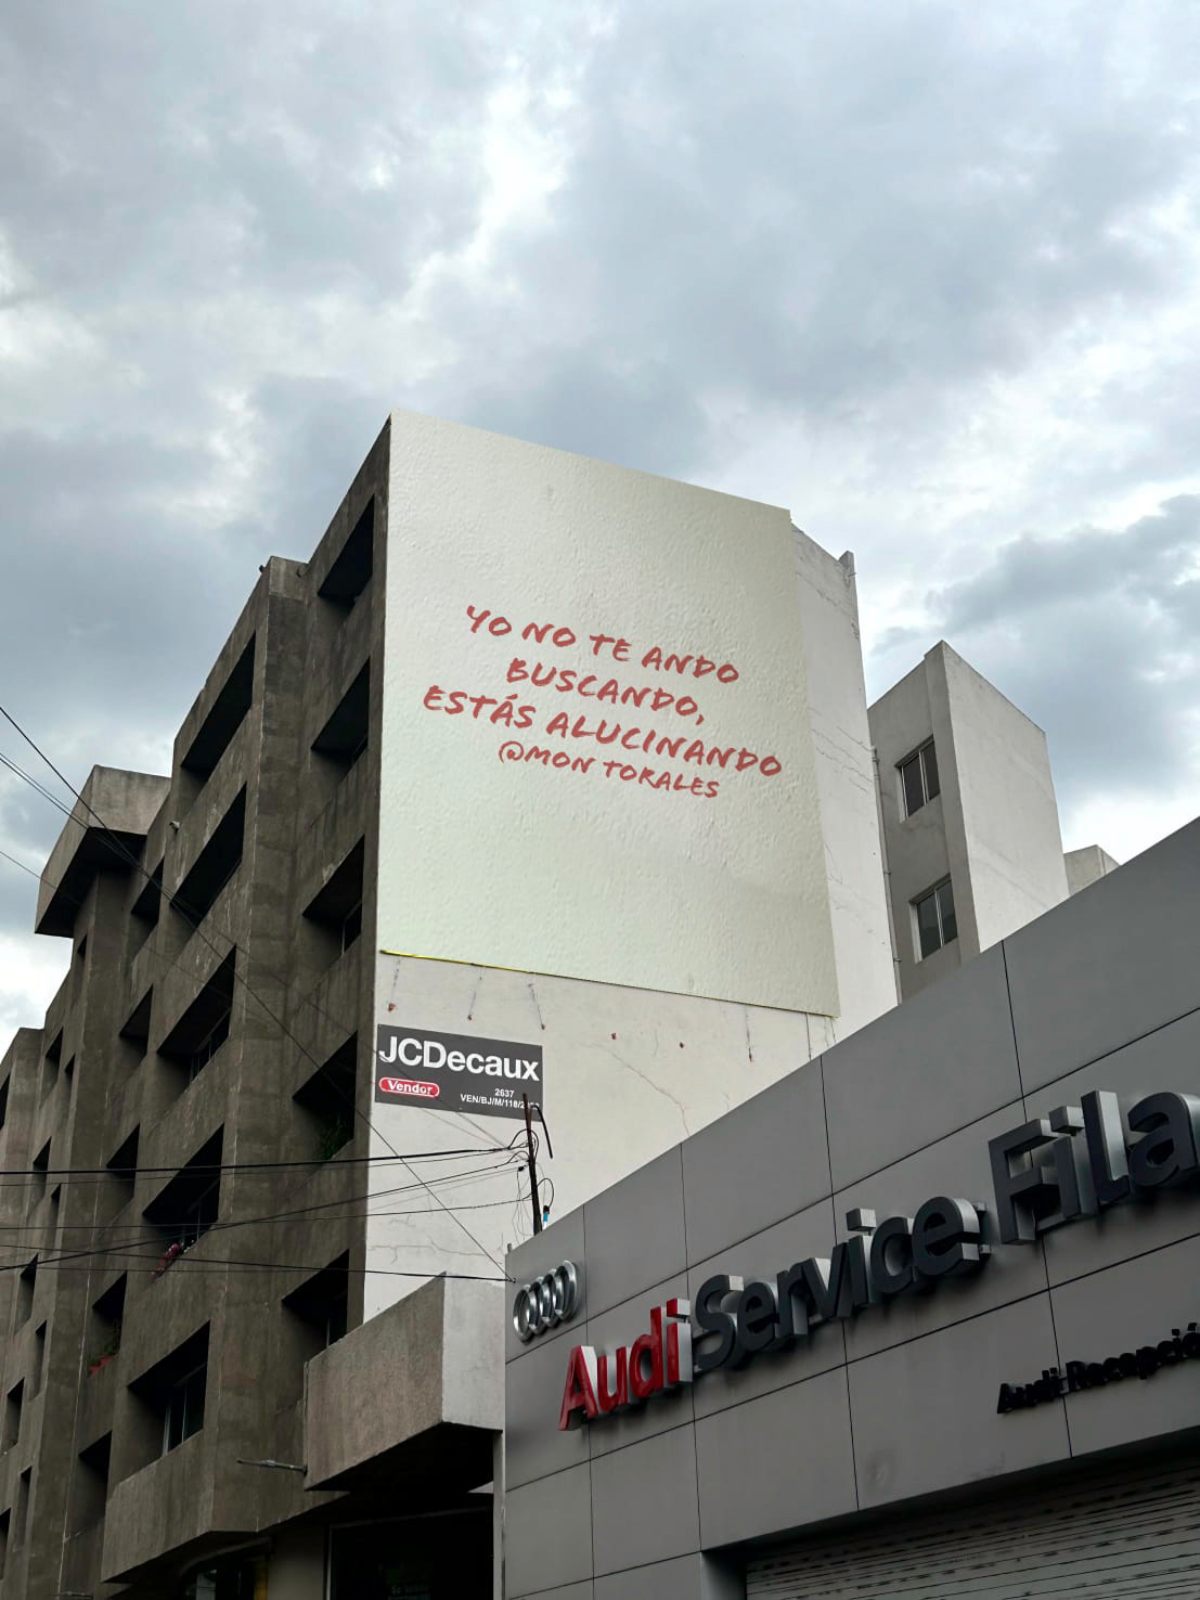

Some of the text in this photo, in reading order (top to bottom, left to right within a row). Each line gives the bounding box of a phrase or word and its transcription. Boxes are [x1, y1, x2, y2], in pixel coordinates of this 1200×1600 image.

[466, 605, 740, 684] YO NO TE ANDO
[506, 657, 705, 726] BUSCANDO,
[422, 684, 783, 777] ESTÁS ALUCINANDO
[378, 1036, 541, 1082] JCDecaux
[386, 1078, 434, 1097] Vendor
[494, 1087, 516, 1098] 2637
[559, 1298, 693, 1431] Audi
[694, 1196, 982, 1374] Service
[997, 1367, 1064, 1415] Audi
